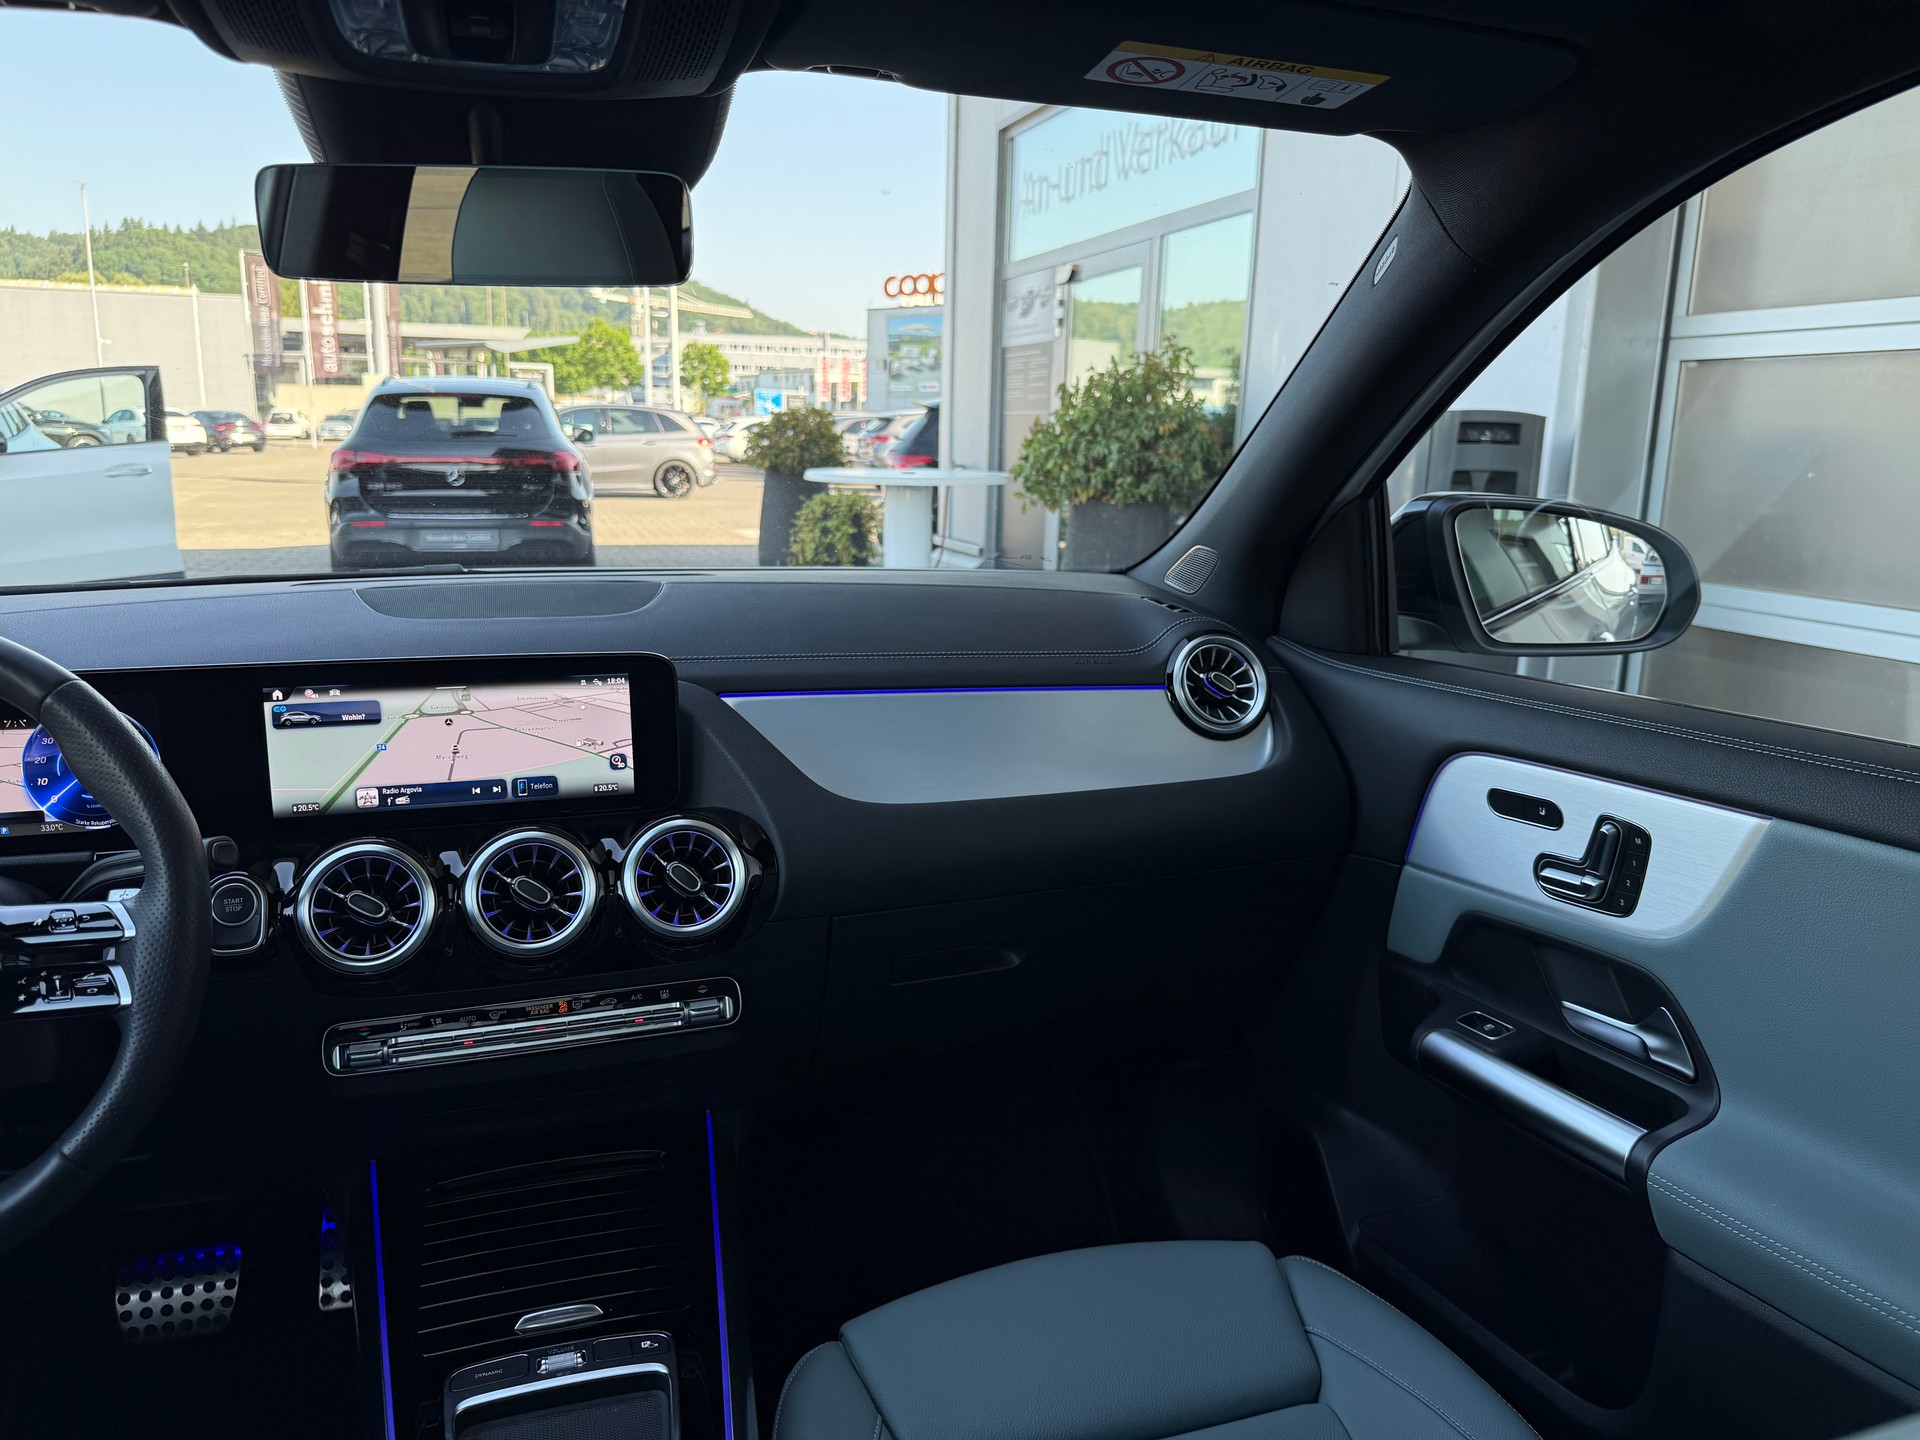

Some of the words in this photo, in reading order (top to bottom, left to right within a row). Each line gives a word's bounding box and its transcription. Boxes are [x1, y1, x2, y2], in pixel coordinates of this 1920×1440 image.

[1227, 56, 1315, 75] AIRBAG
[342, 713, 366, 721] Wohin?
[400, 786, 423, 794] Argovia
[530, 782, 553, 790] Telefon
[598, 783, 618, 792] 20.5°C
[297, 803, 319, 812] 20.5°C
[1626, 879, 1631, 887] 2
[223, 897, 243, 905] START
[525, 1003, 553, 1011] PASSENGER
[474, 1368, 503, 1378] DYNAMIC
